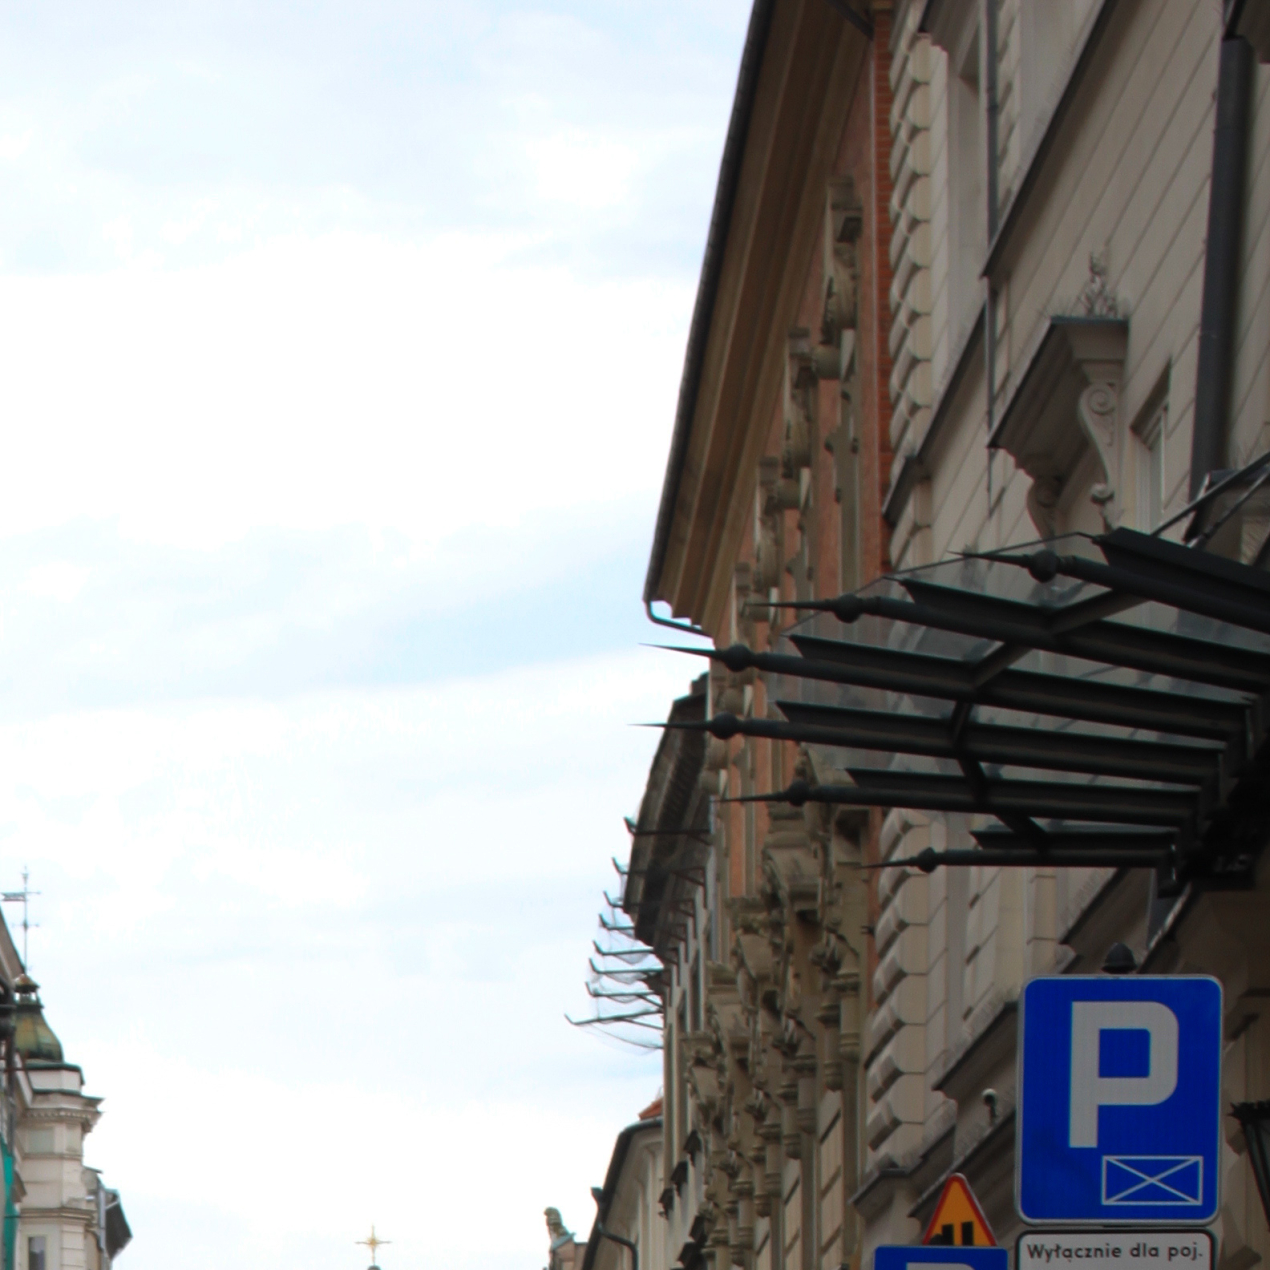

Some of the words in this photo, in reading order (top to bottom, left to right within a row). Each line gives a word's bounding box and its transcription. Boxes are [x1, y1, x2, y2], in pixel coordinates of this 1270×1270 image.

[1068, 1001, 1179, 1149] P
[1027, 1243, 1122, 1263] Wyłącznie
[1130, 1243, 1160, 1258] dla
[1168, 1242, 1203, 1261] poj.
